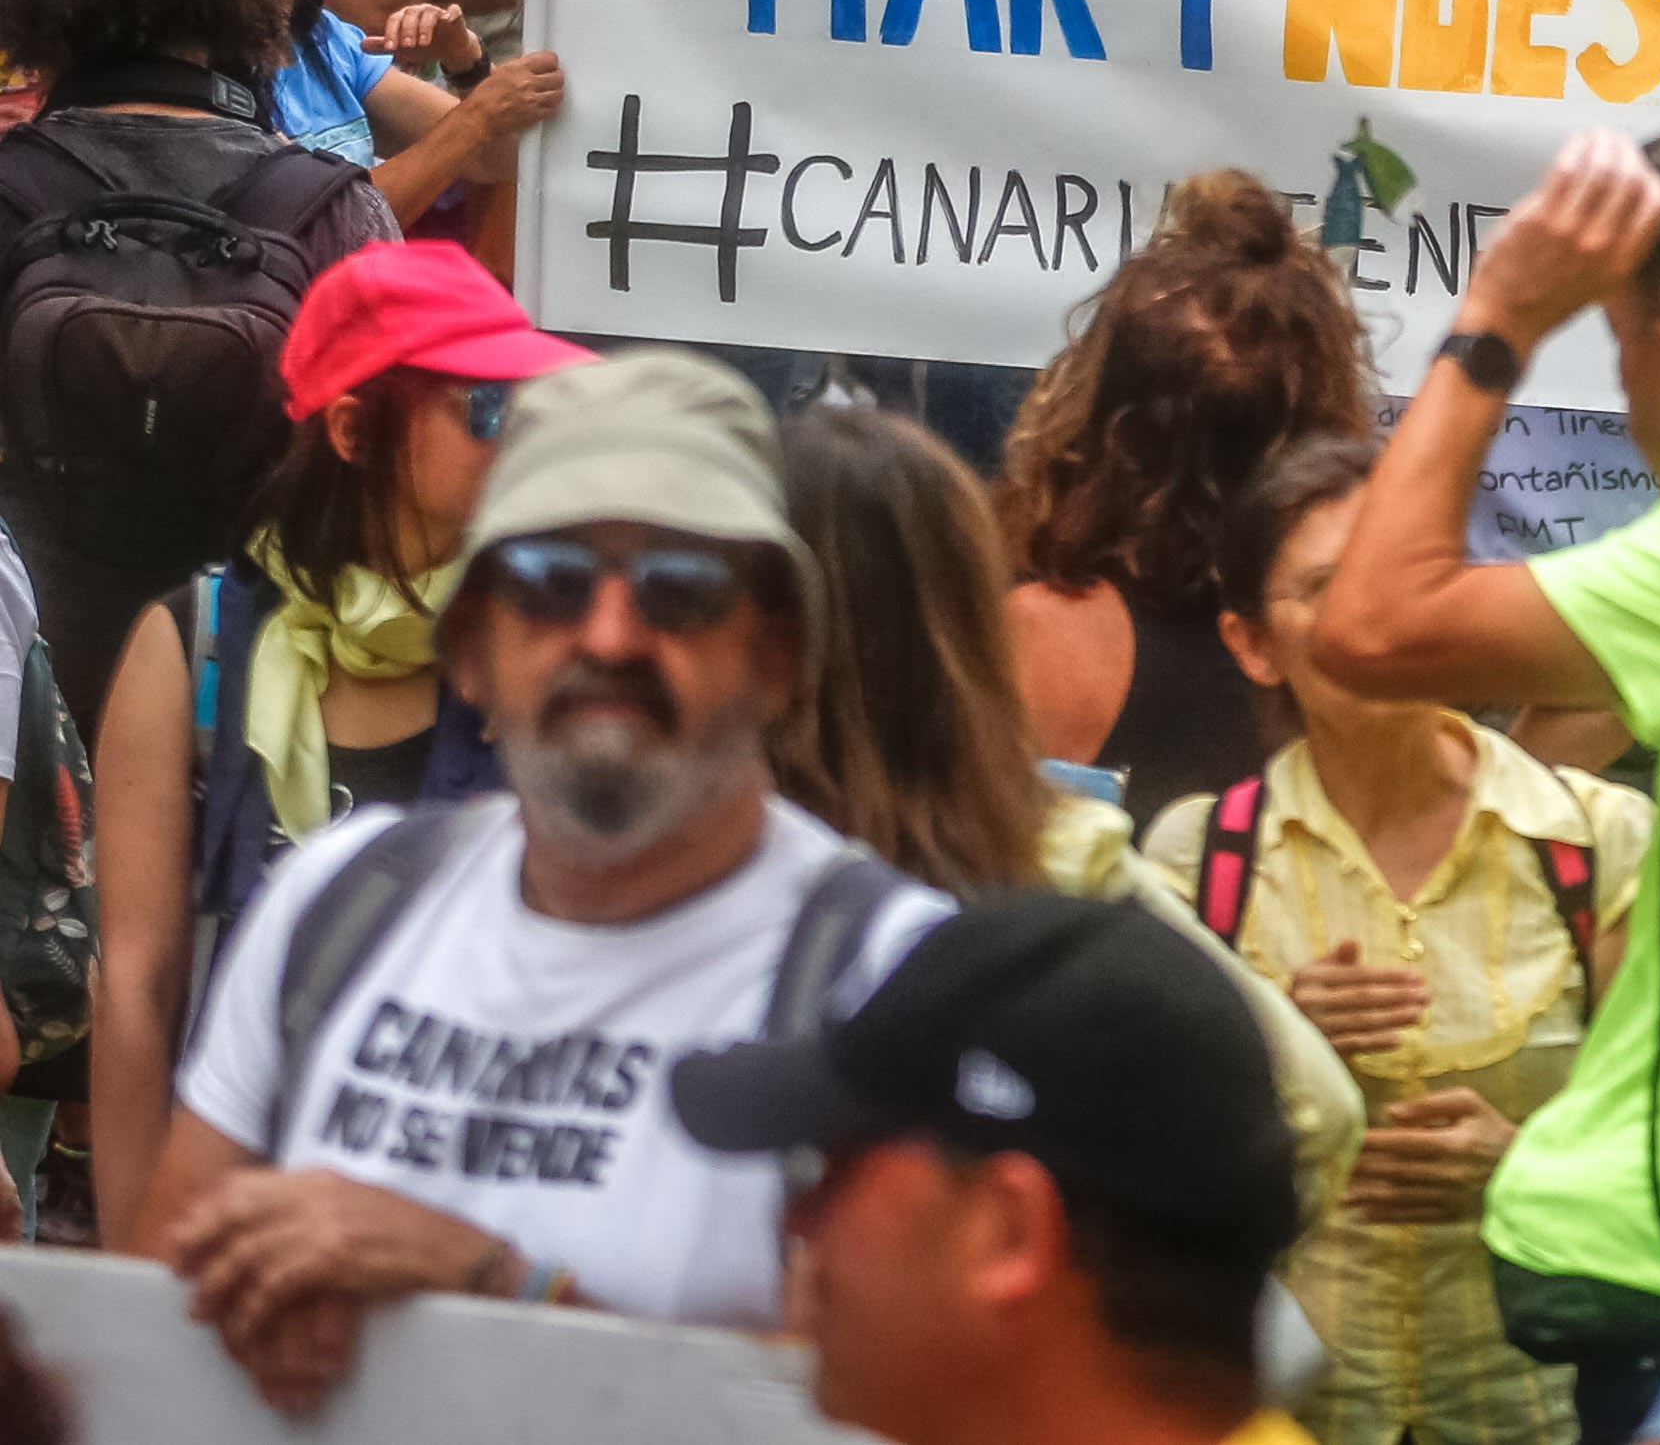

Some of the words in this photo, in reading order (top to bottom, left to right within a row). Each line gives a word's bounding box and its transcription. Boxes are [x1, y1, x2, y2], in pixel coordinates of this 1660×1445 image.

[353, 1000, 655, 1110] CANARIAS
[322, 1084, 392, 1155] NO
[388, 1105, 446, 1168] SE
[461, 1114, 622, 1188] VENDE
